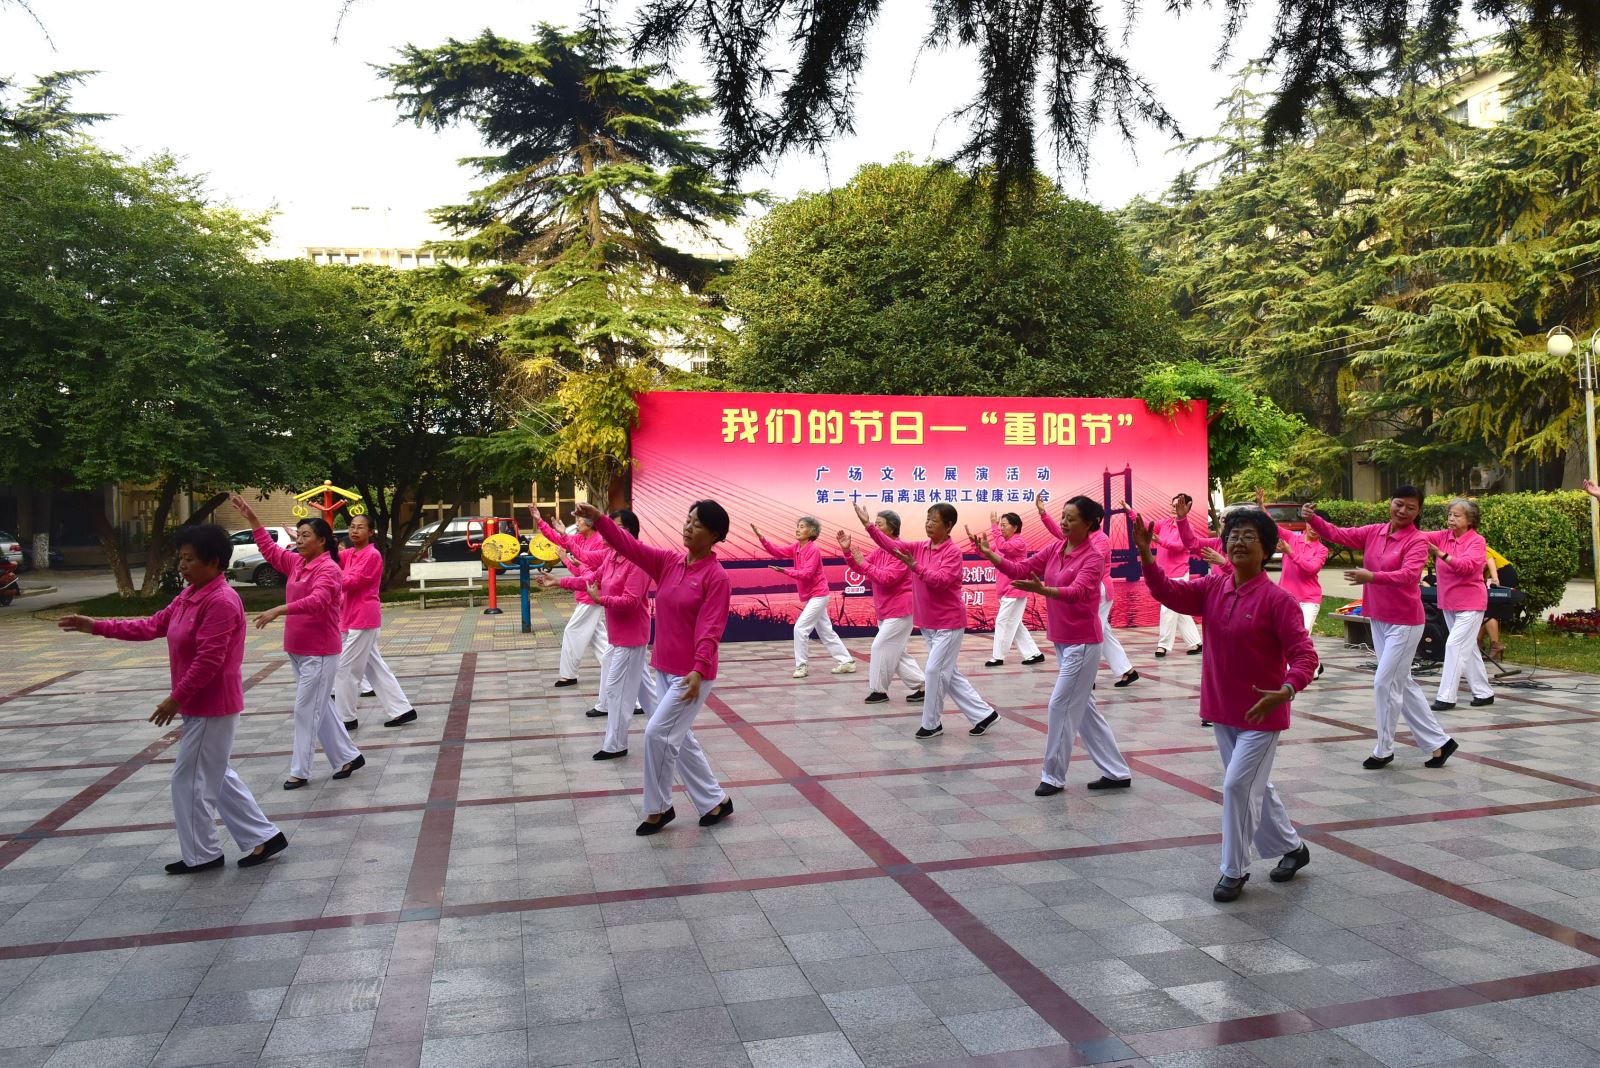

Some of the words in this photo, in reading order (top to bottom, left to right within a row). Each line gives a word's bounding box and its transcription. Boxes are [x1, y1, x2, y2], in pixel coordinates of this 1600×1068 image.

[815, 466, 1051, 481] 广场文化展演活动
[816, 488, 1050, 503] 第二十一届离退休职工健康运动会
